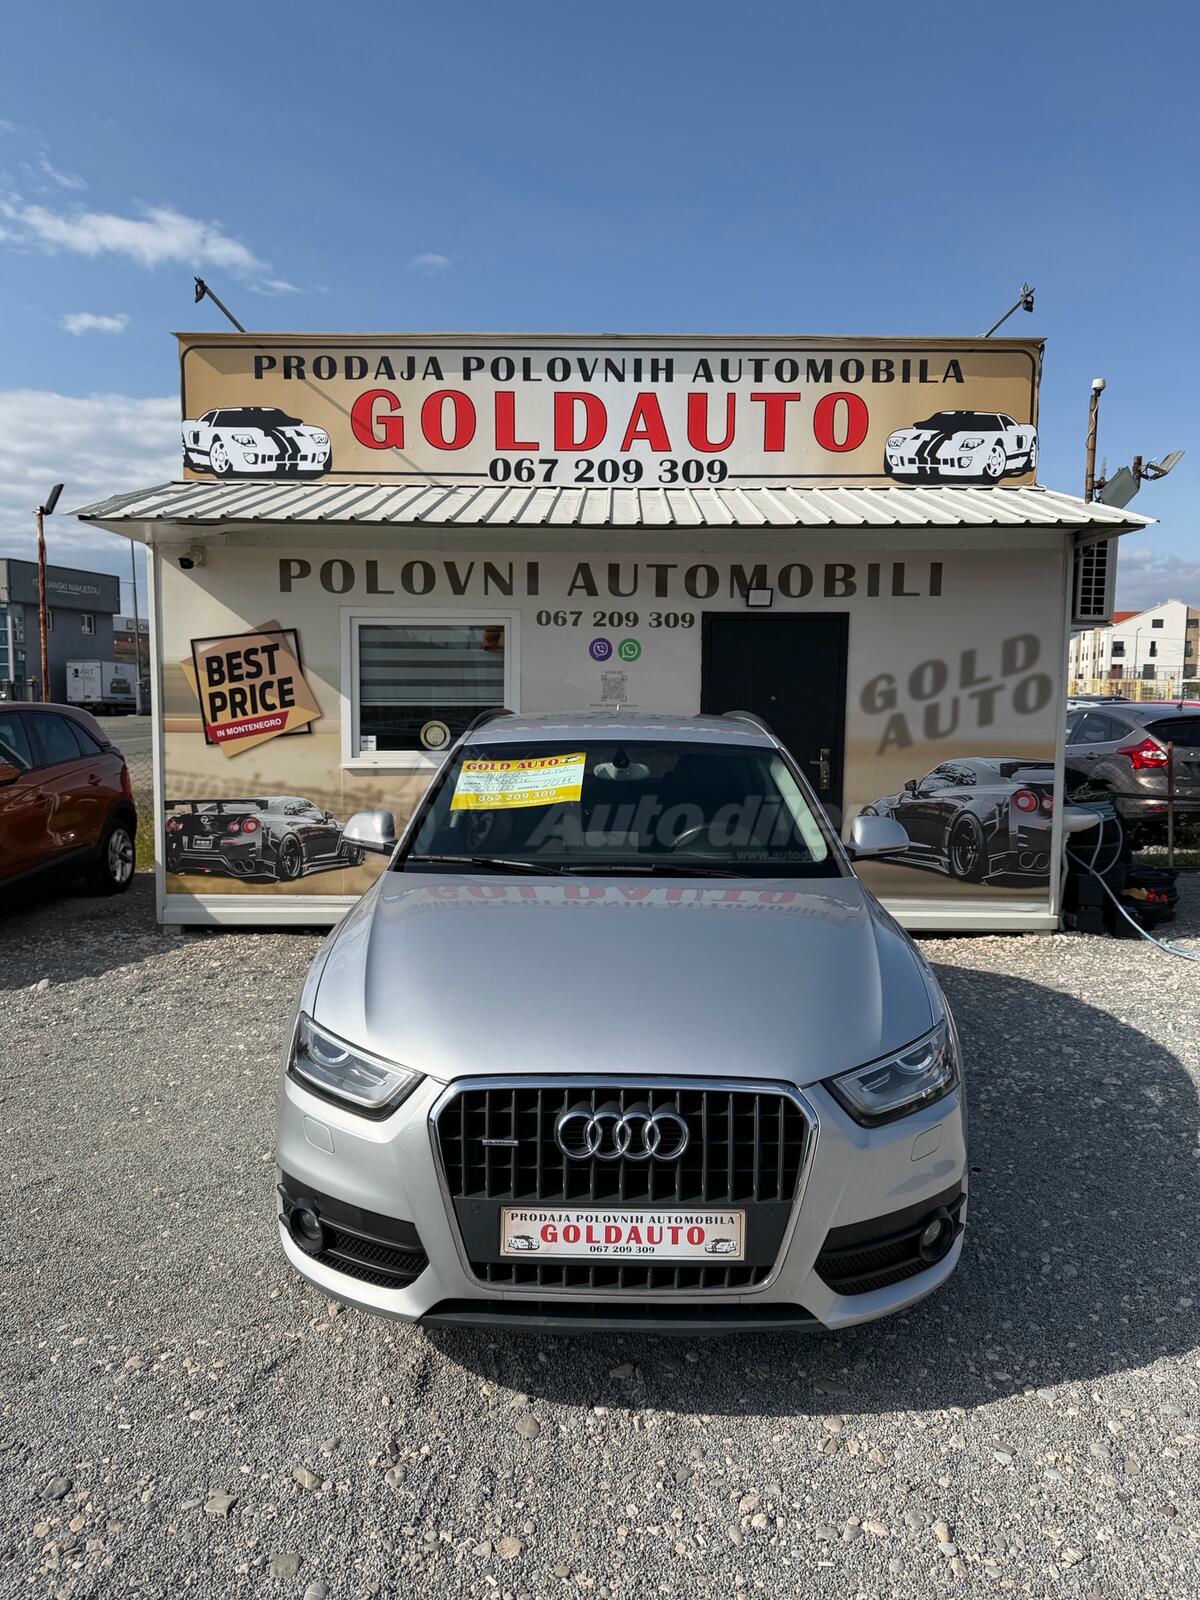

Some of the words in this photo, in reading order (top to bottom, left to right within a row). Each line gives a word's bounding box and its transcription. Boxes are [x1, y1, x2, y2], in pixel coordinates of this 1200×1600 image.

[254, 354, 444, 381] PRODAJA
[462, 356, 674, 383] POLOVNIH
[692, 358, 965, 384] AUTOMOBILA
[350, 388, 869, 453] GOLDAUTO
[488, 458, 557, 482] 067
[574, 458, 644, 483] 209
[658, 459, 728, 484] 309
[279, 558, 540, 596] POLOVNI
[567, 562, 943, 599] AUTOMOBILI
[536, 610, 583, 627] 067
[592, 611, 639, 628] 209
[648, 611, 696, 629] 309
[205, 643, 279, 688] BEST
[858, 633, 1041, 715] GOLD
[208, 676, 295, 723] PRICE
[216, 729, 226, 738] IN
[226, 718, 282, 736] MONTENEGRO
[876, 672, 1053, 756] AUTO
[466, 762, 512, 771] GOLD
[517, 758, 560, 770] AUTO
[510, 1212, 571, 1223] PRODAJA
[576, 1214, 644, 1224] POLOVNIH
[648, 1215, 735, 1225] AUTOMOBILA
[540, 1224, 706, 1246] GOLDAUTO
[589, 1245, 609, 1253] 067
[635, 1246, 655, 1254] 309
